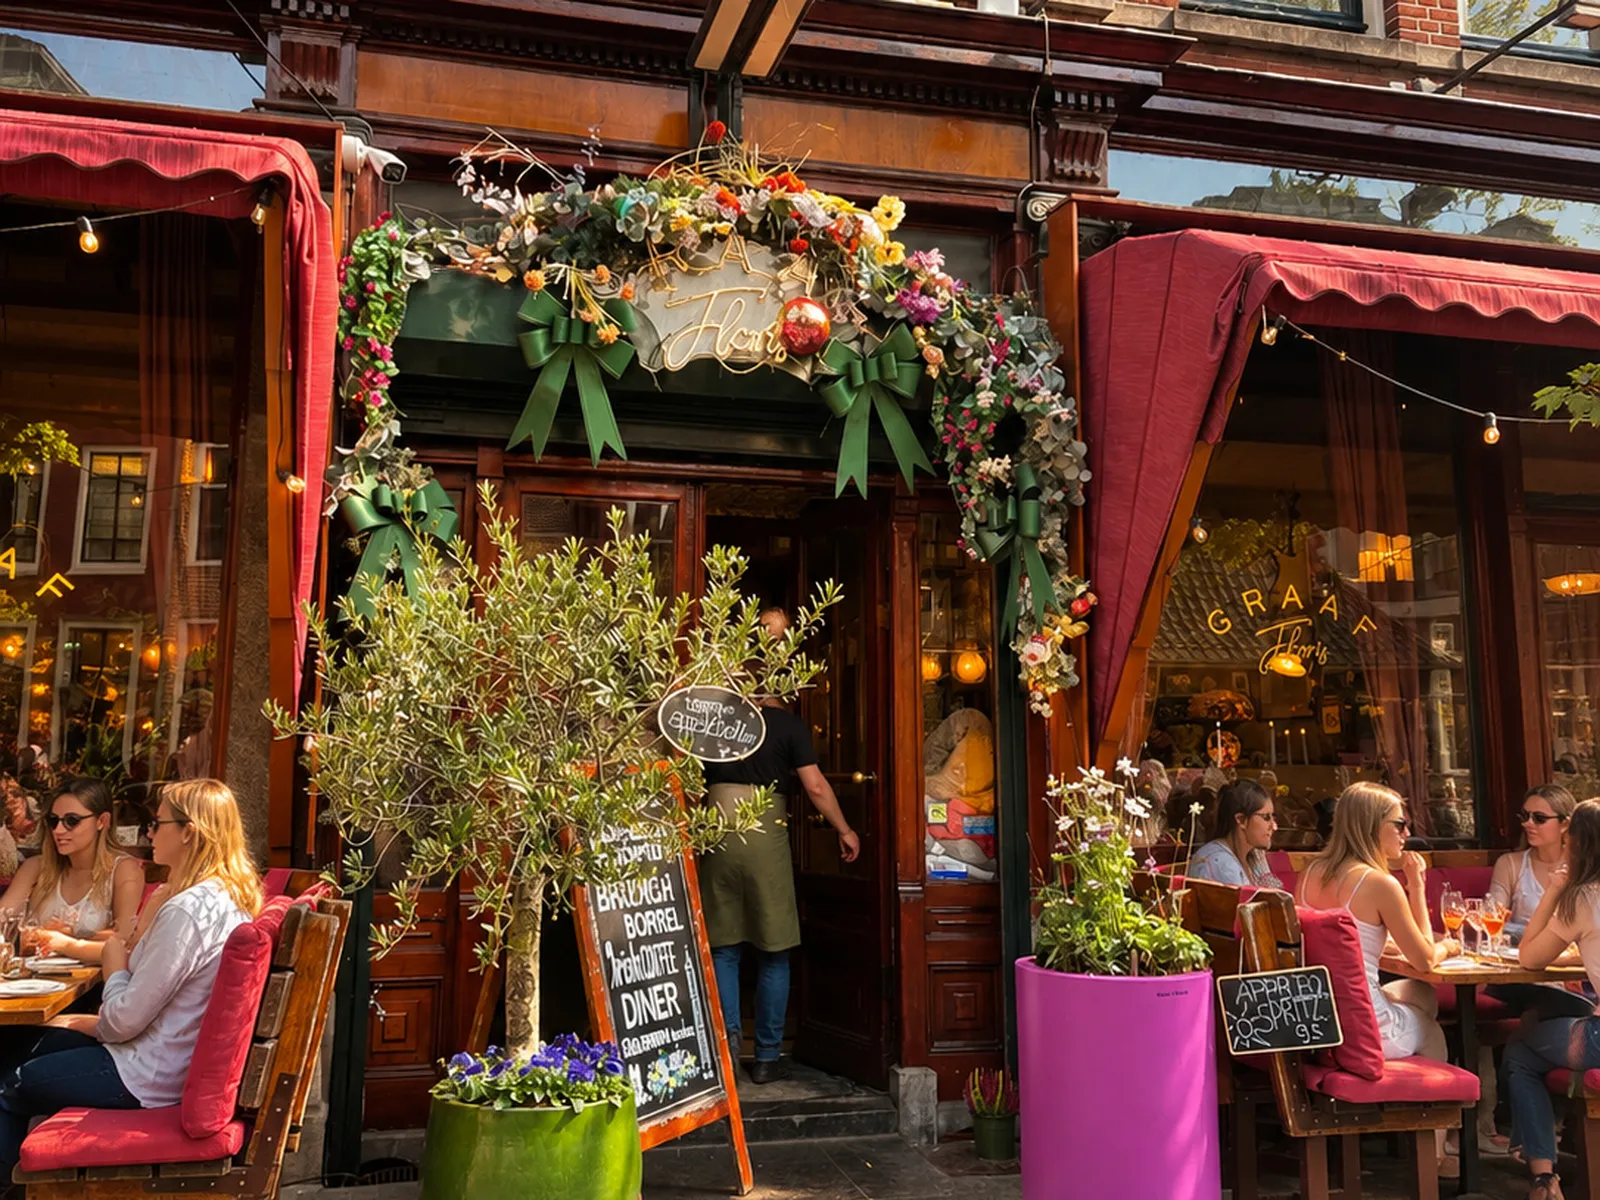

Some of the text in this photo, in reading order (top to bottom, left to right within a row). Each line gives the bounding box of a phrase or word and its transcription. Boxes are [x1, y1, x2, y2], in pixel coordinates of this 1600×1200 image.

[1207, 584, 1378, 636] GRAAF
[624, 906, 684, 940] BORREL
[620, 981, 683, 1030] DINER
